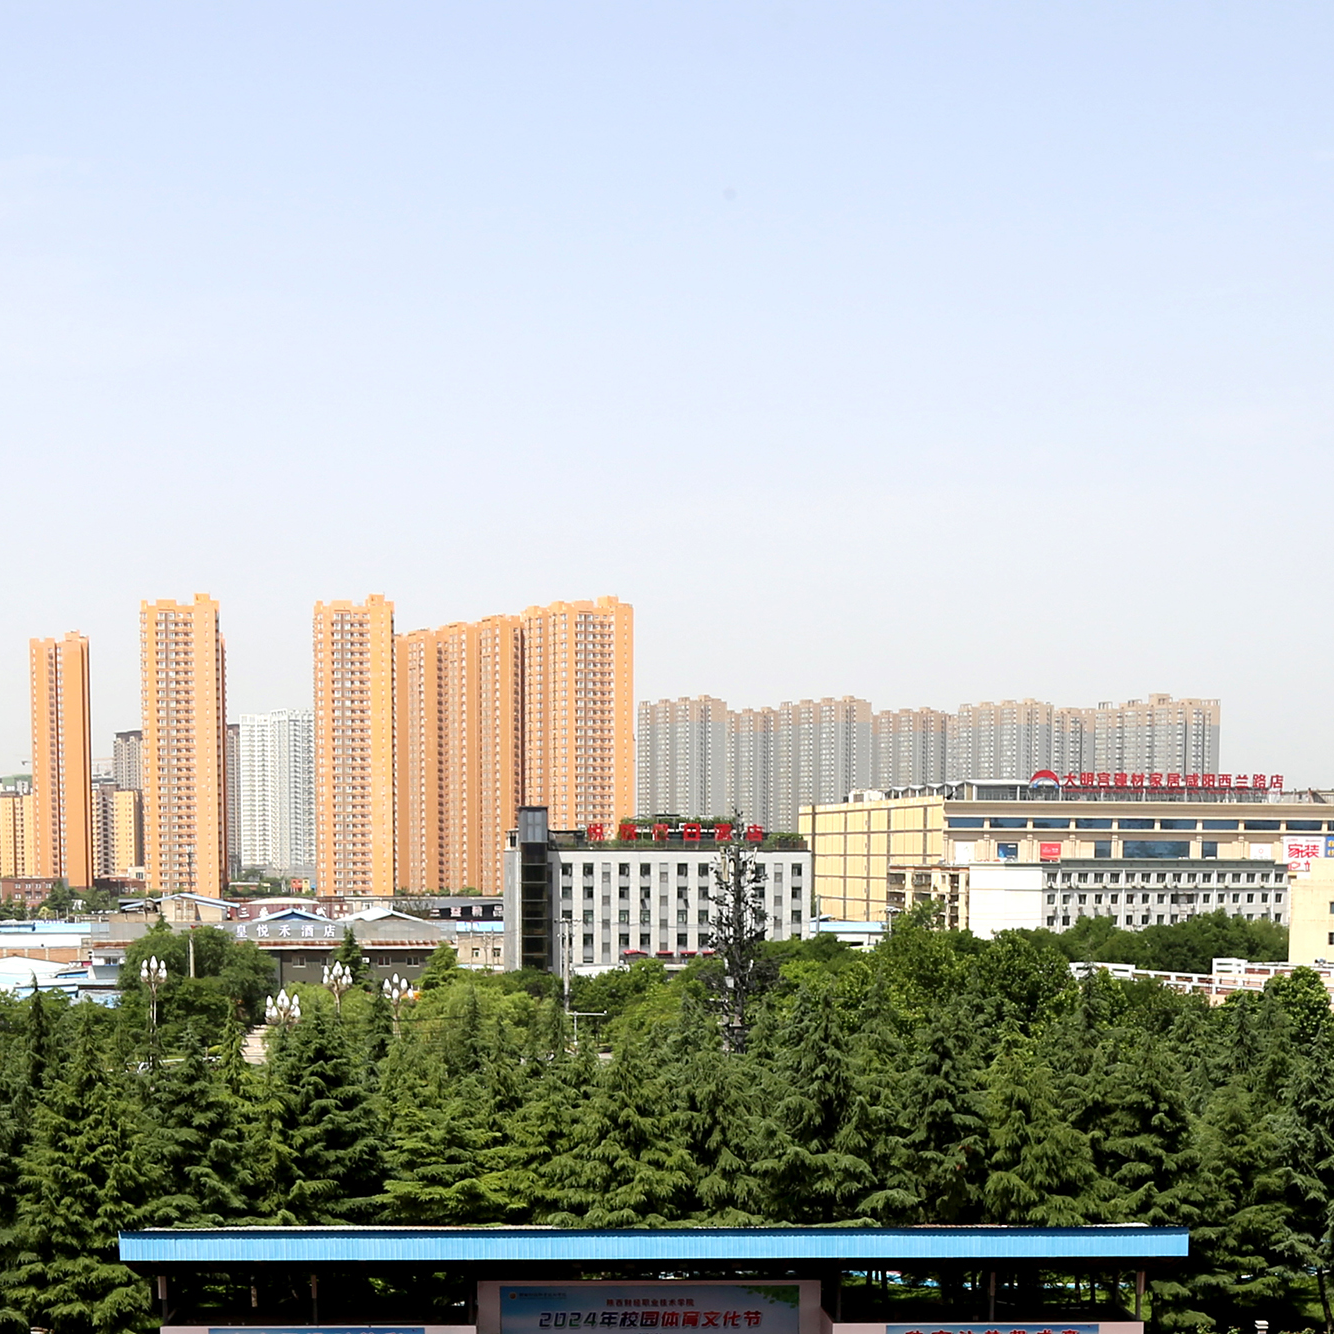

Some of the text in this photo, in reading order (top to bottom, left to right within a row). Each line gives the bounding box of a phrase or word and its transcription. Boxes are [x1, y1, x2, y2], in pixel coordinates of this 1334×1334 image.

[1063, 772, 1284, 789] 大明宫建材家居咸阳西兰路店
[538, 1310, 763, 1329] 2024年校园体育文化节
